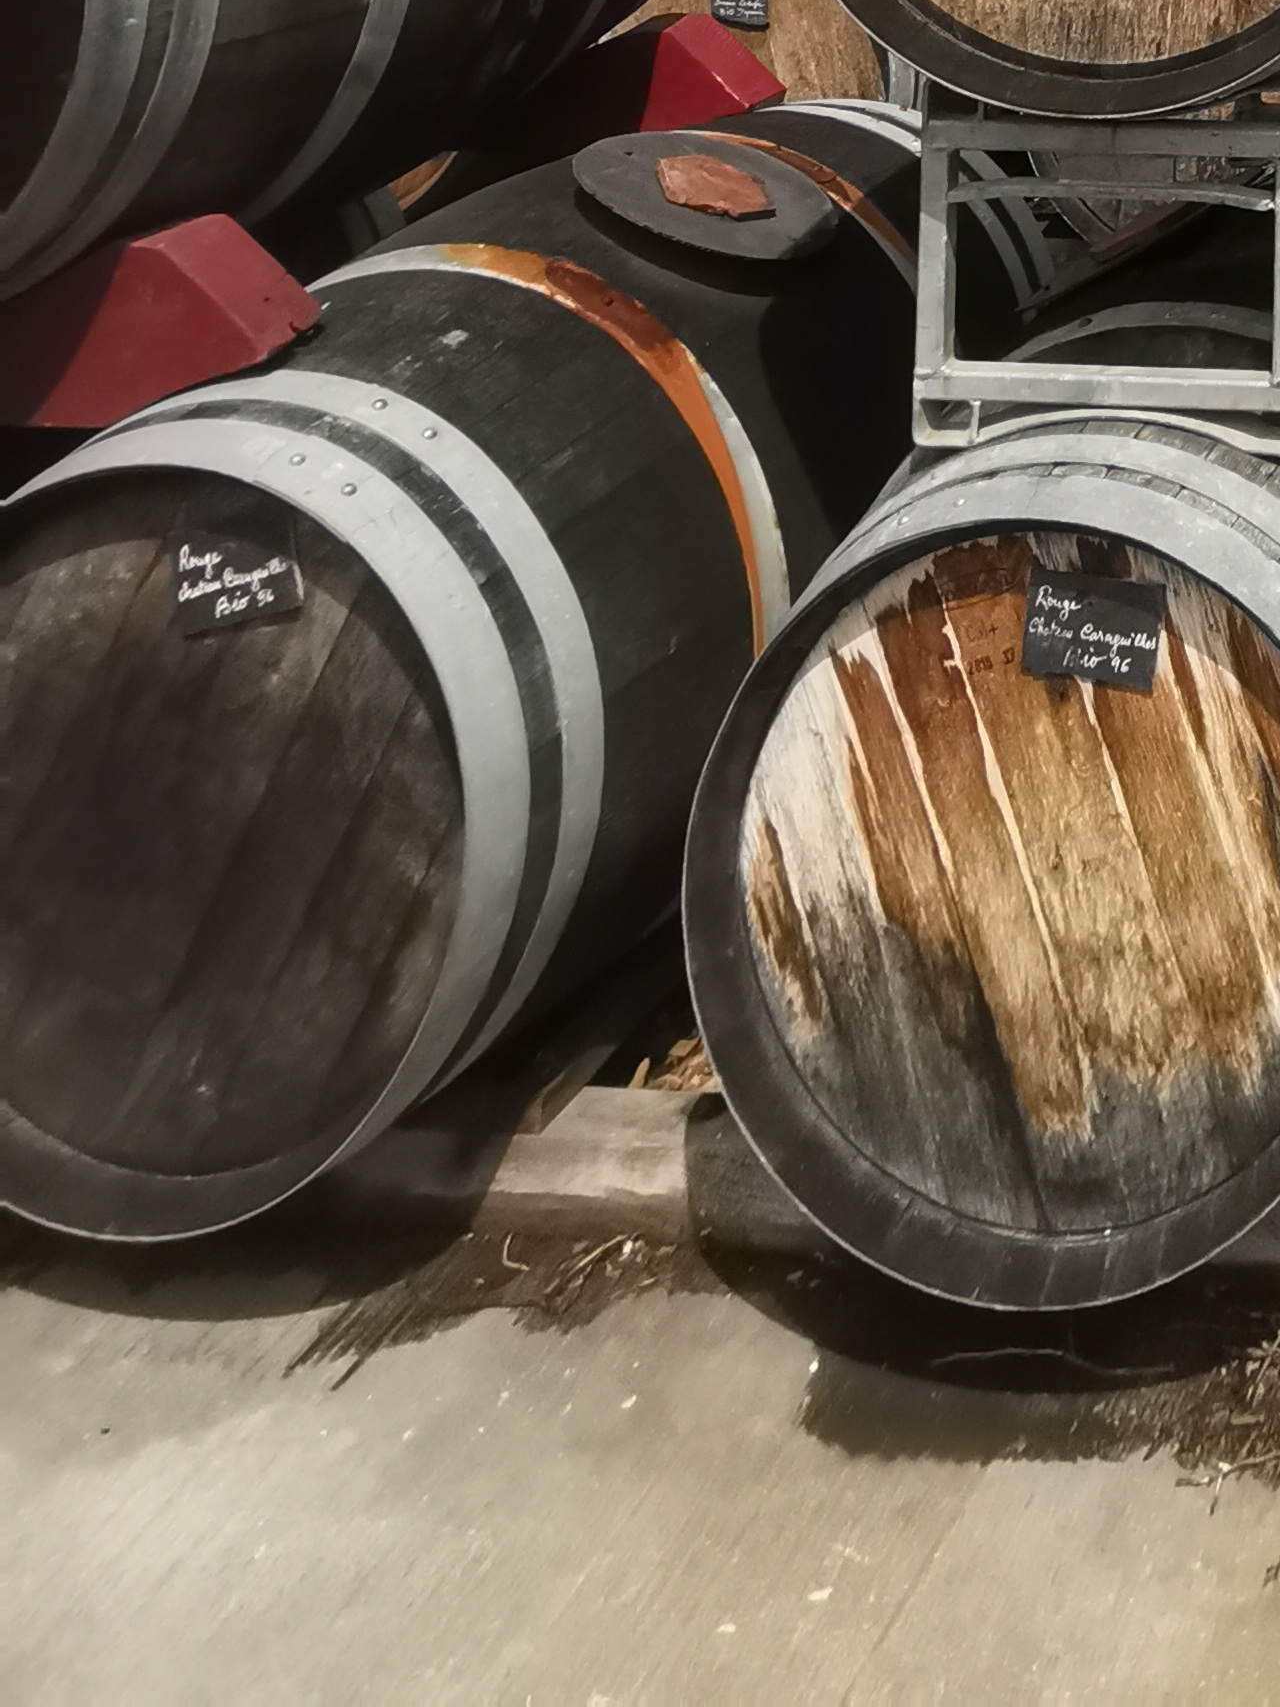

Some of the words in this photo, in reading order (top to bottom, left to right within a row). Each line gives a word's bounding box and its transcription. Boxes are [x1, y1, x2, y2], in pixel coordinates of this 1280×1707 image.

[178, 544, 223, 579] Rouge
[1035, 585, 1082, 620] Rouge
[1111, 656, 1131, 673] 96
